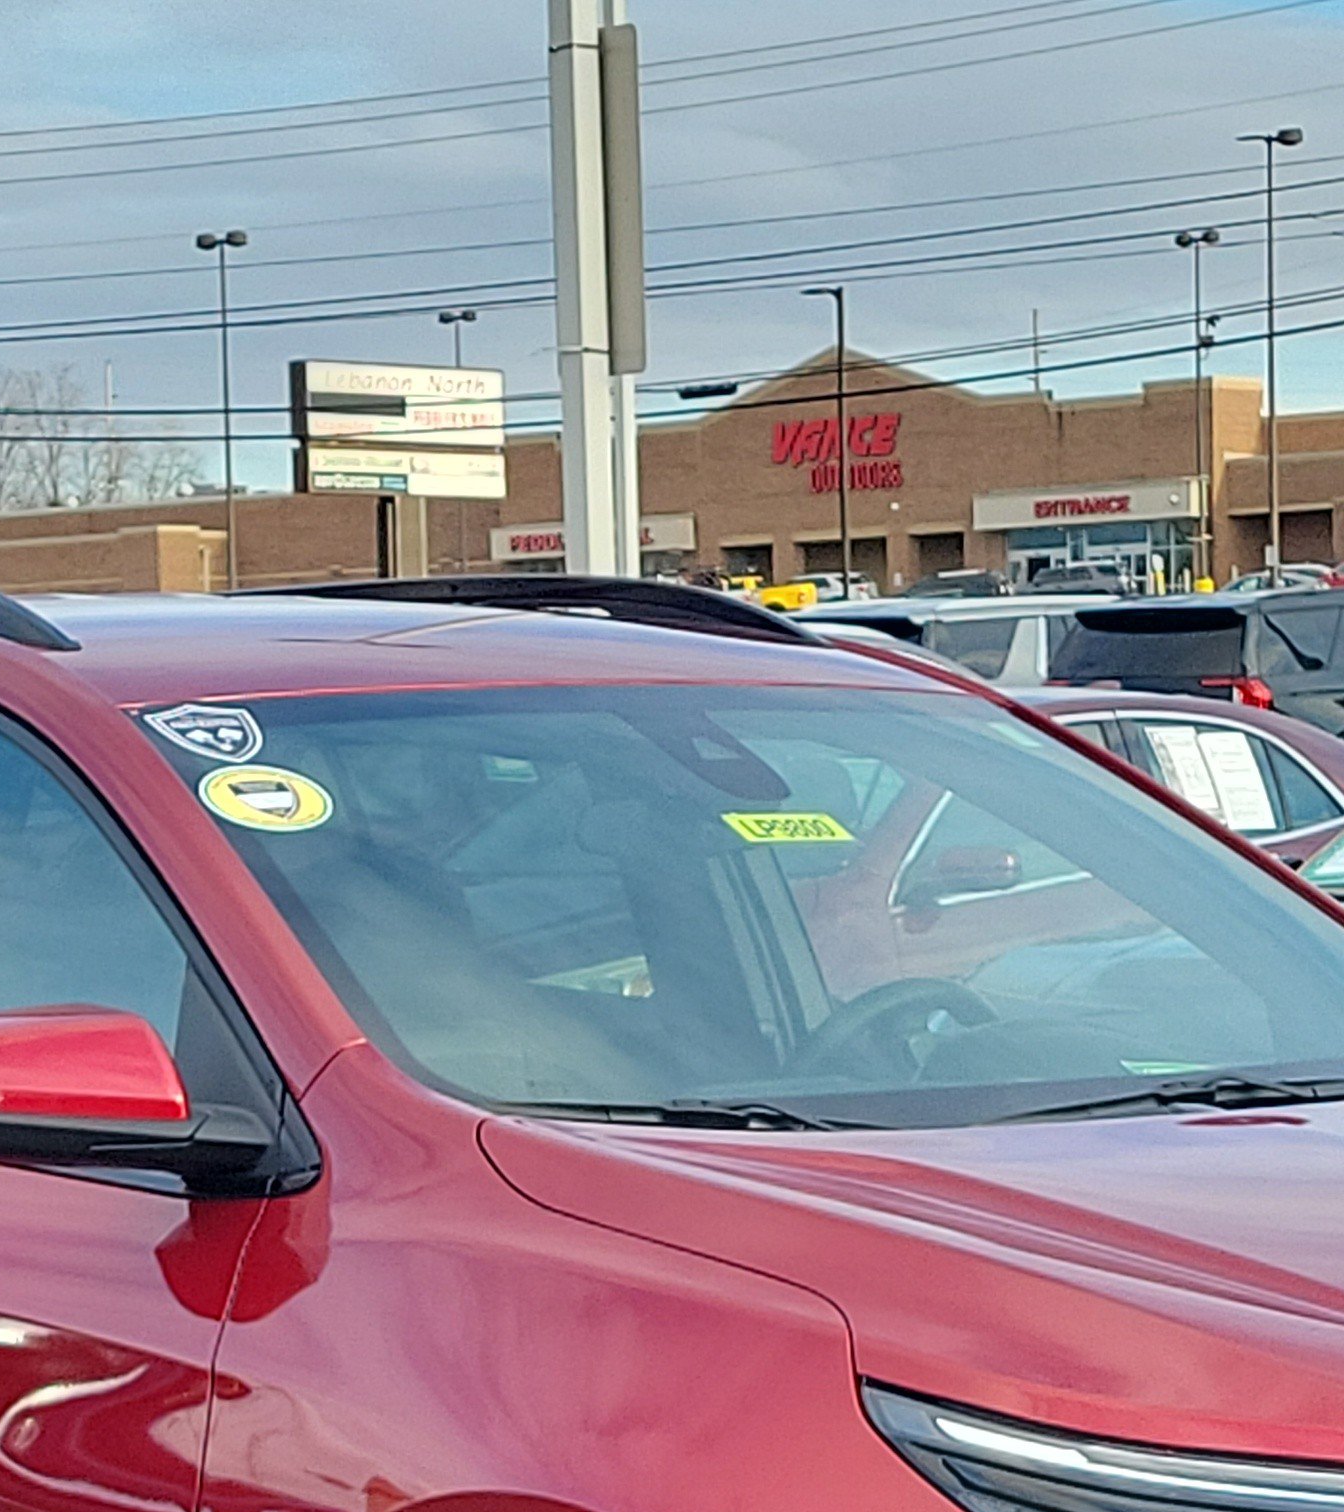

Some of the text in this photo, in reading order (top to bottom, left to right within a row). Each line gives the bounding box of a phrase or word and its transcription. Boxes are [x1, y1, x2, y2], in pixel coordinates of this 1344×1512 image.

[324, 370, 486, 395] Lebanon North
[771, 412, 902, 467] VANCE
[810, 460, 904, 493] OUDOORS
[1033, 495, 1131, 518] ENTRANCE
